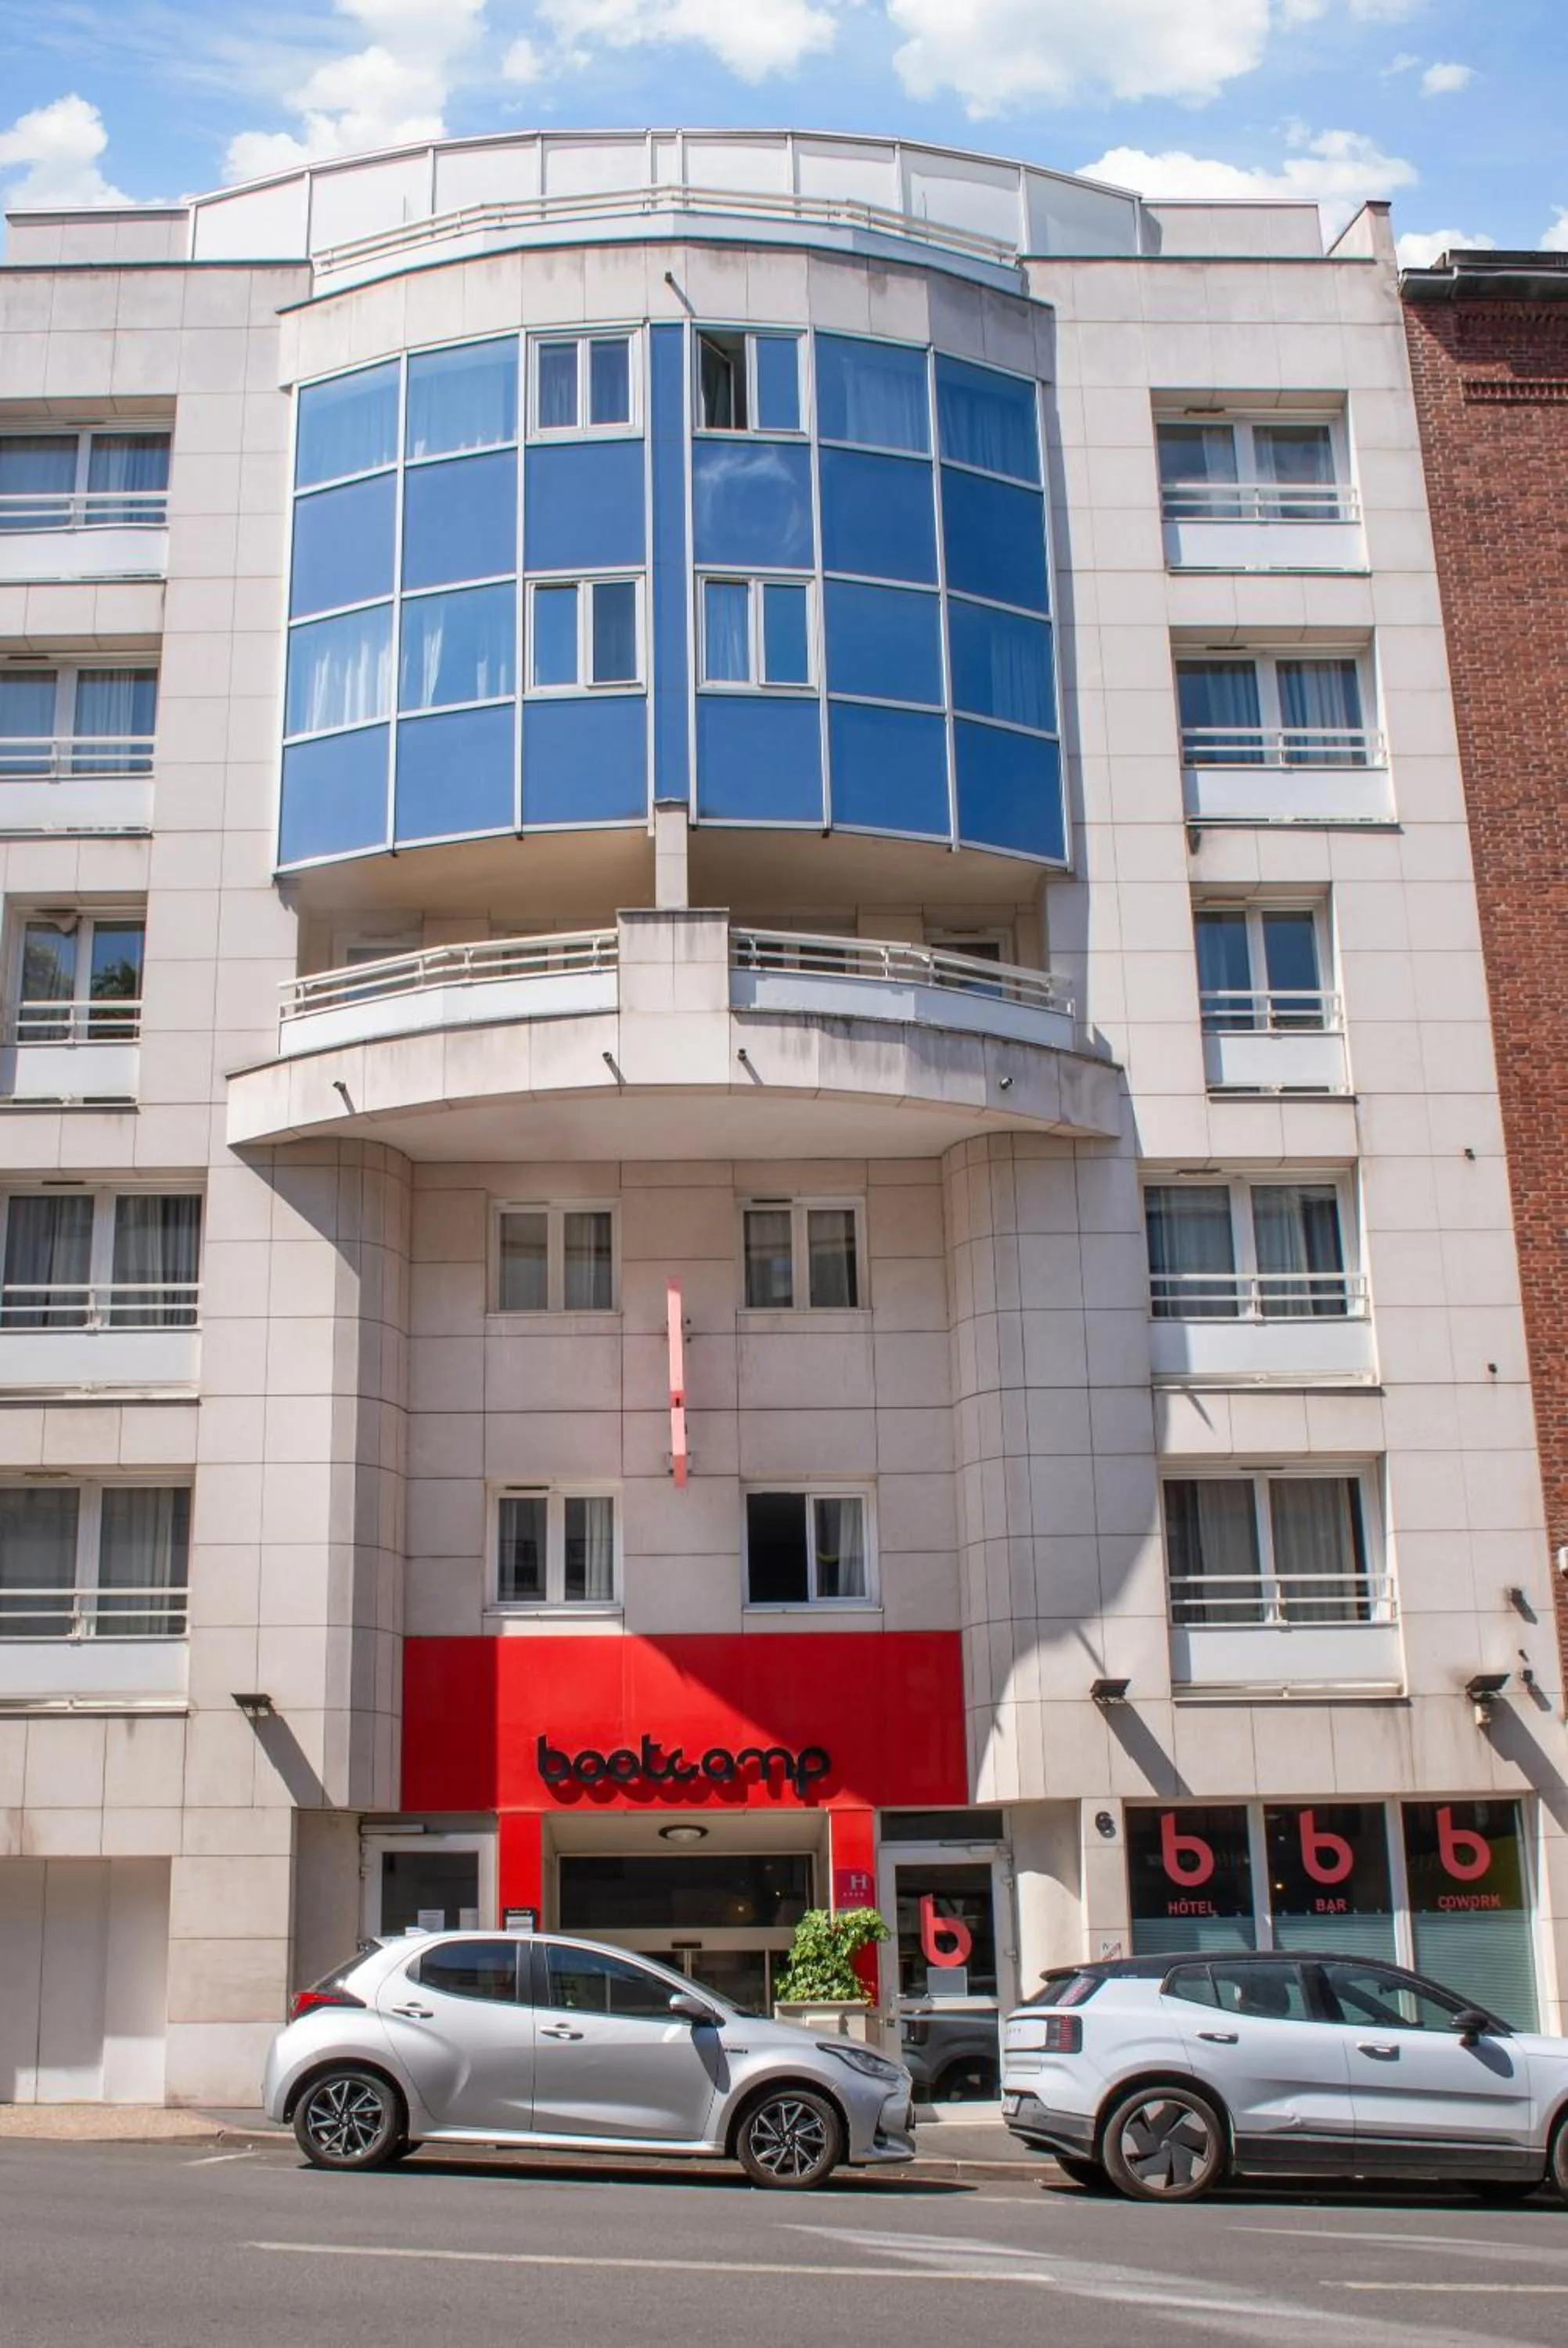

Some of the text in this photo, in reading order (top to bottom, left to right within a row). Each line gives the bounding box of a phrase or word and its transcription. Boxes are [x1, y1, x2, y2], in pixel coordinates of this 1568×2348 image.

[538, 1734, 831, 1795] bootcamp
[1160, 1811, 1215, 1886] b
[1299, 1810, 1354, 1885] b
[1437, 1806, 1491, 1882] b
[851, 1874, 868, 1890] H
[1315, 1898, 1347, 1911] BAR
[1438, 1894, 1501, 1908] COWORK
[919, 1892, 972, 1968] b
